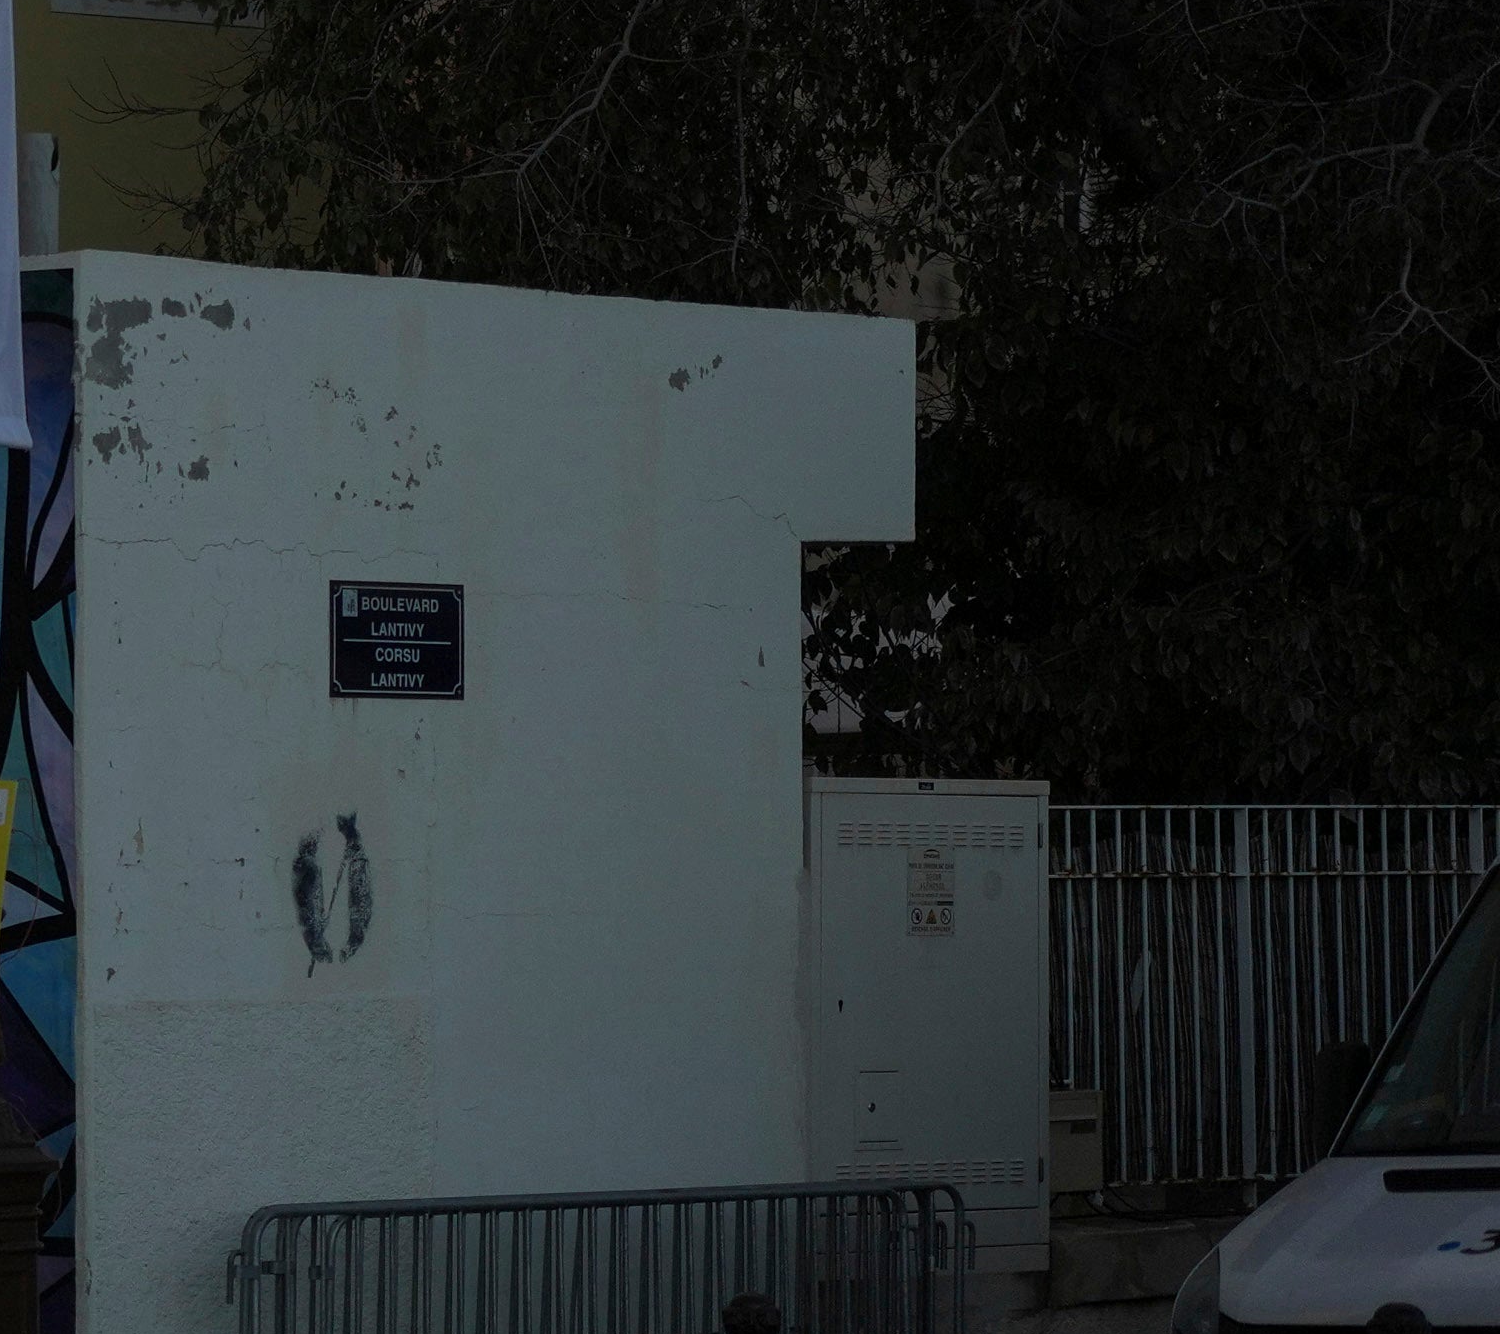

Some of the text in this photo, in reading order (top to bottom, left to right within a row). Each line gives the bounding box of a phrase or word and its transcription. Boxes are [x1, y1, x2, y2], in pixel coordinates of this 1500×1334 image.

[361, 596, 440, 613] BOULEVARD
[371, 621, 425, 637] LANTIVY
[375, 647, 421, 663] CORSU
[371, 672, 426, 688] LANTIVY
